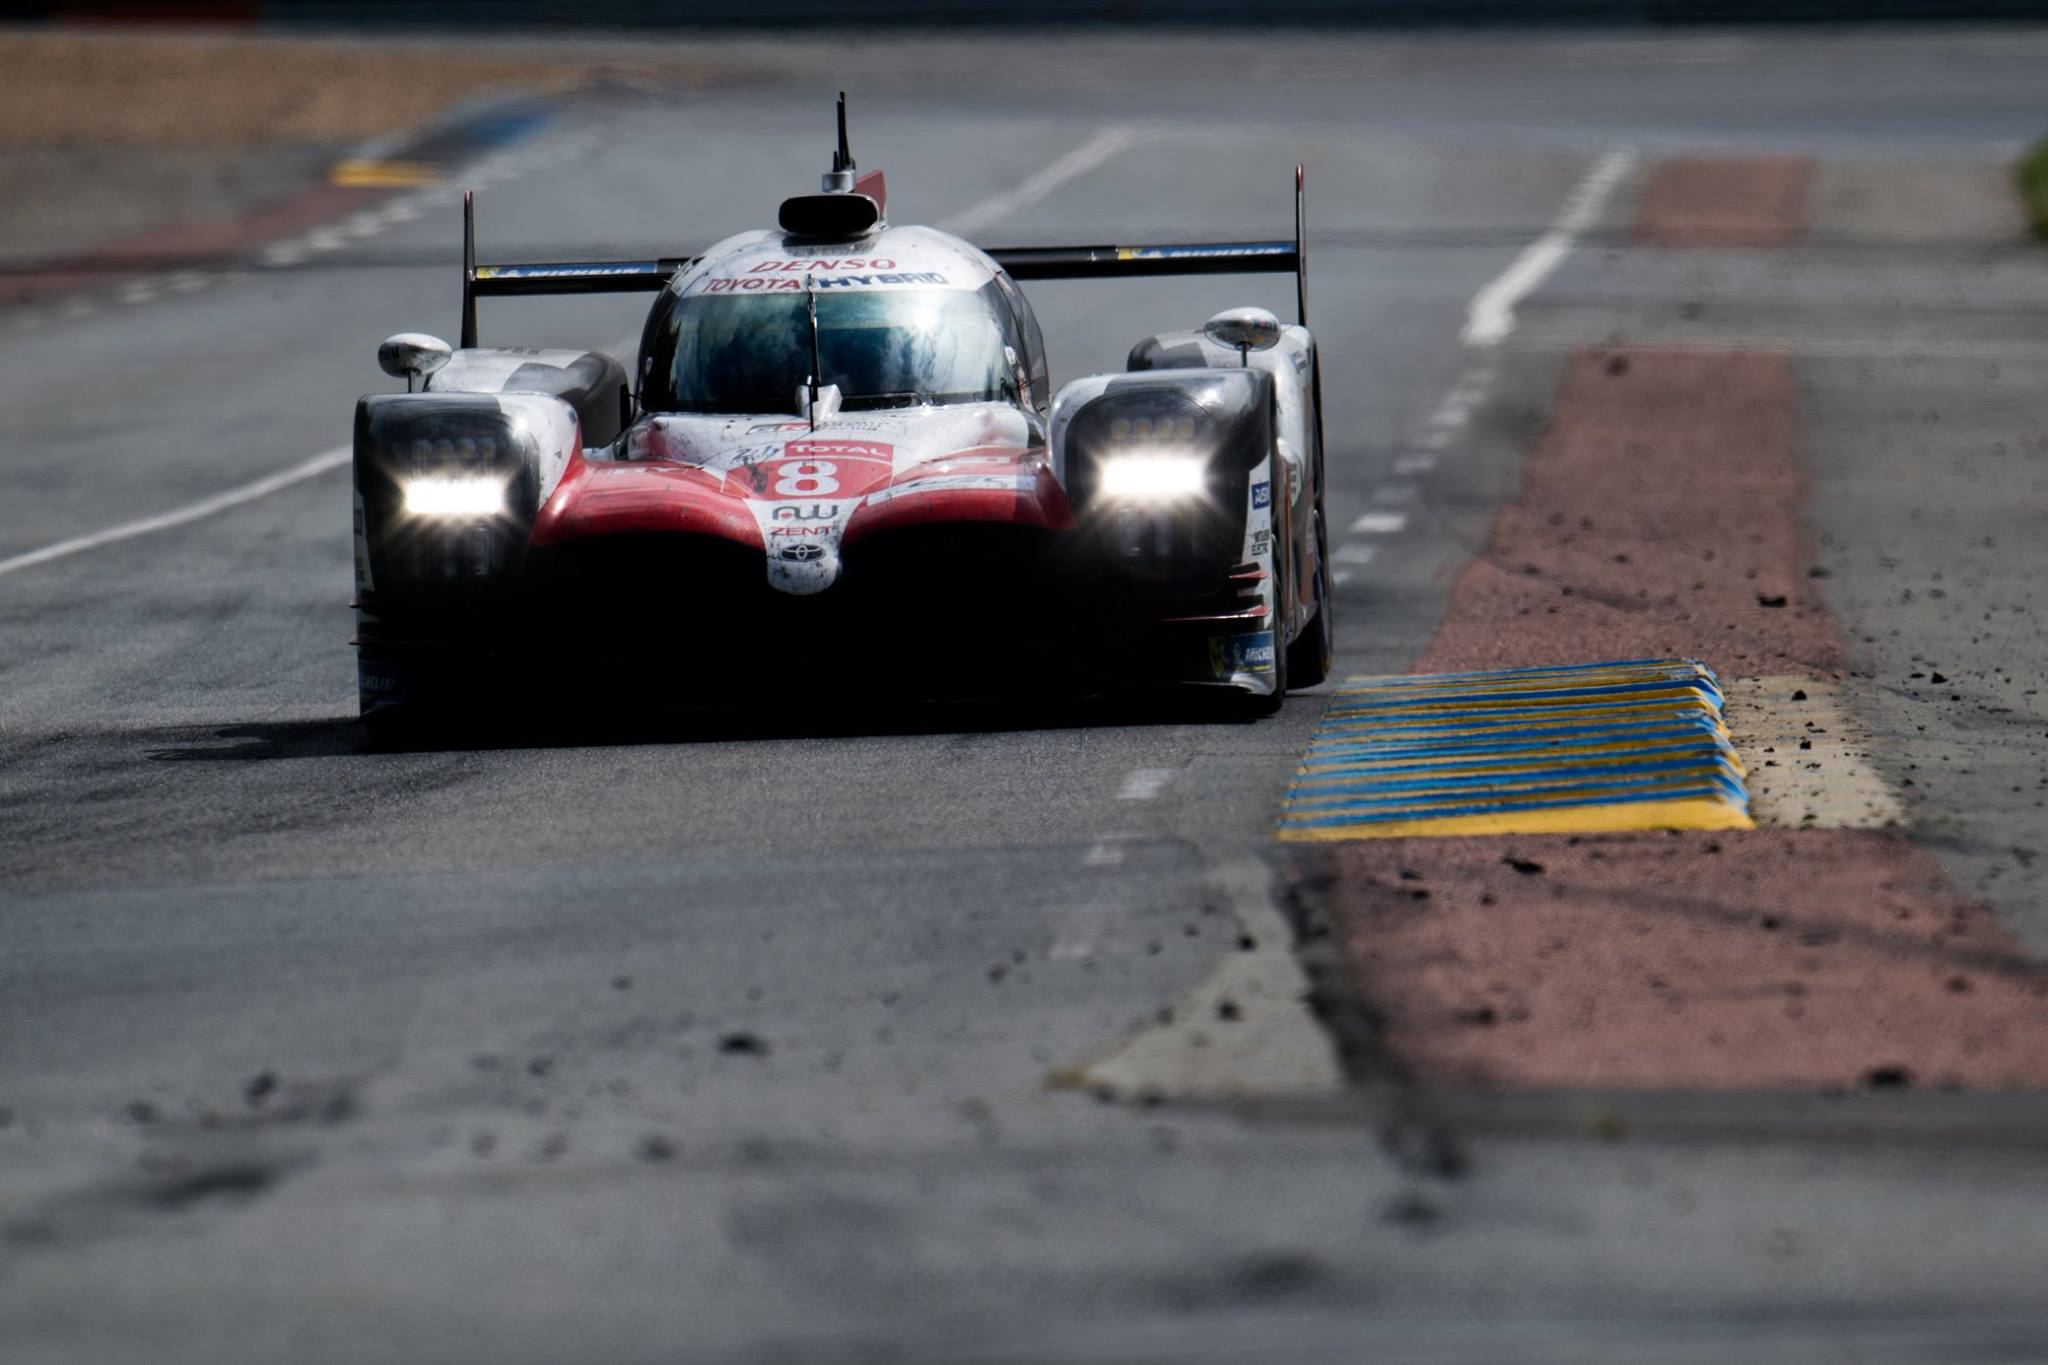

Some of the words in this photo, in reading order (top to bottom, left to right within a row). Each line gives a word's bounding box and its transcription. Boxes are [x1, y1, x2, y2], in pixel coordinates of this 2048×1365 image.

[748, 258, 896, 273] DENSO
[703, 278, 801, 293] TOYOTA
[818, 272, 949, 288] HYBRID
[790, 445, 889, 458] TOTAL
[774, 460, 840, 496] 8
[769, 526, 834, 537] ZENT
